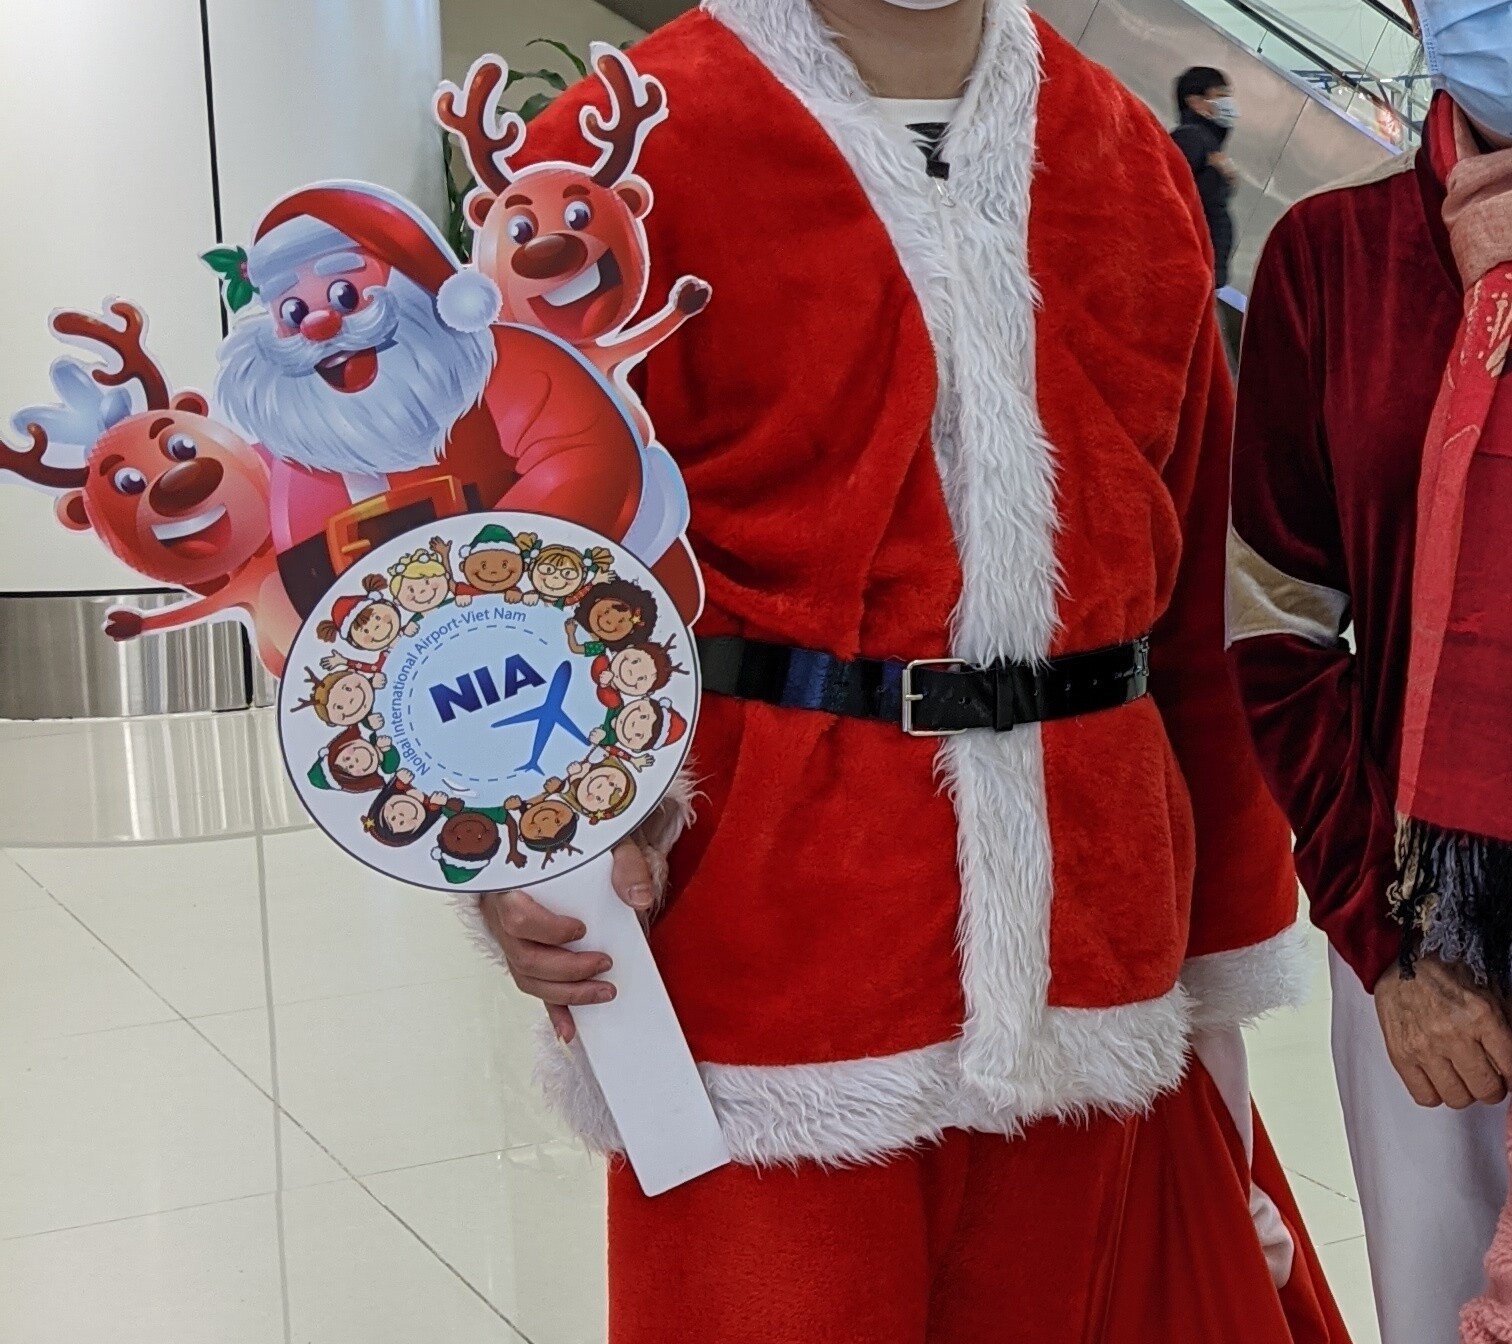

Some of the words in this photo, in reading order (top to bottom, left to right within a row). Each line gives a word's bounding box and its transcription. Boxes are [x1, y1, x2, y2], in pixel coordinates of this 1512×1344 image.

[390, 652, 419, 738] International
[494, 607, 527, 622] Nam
[429, 654, 547, 724] NIA
